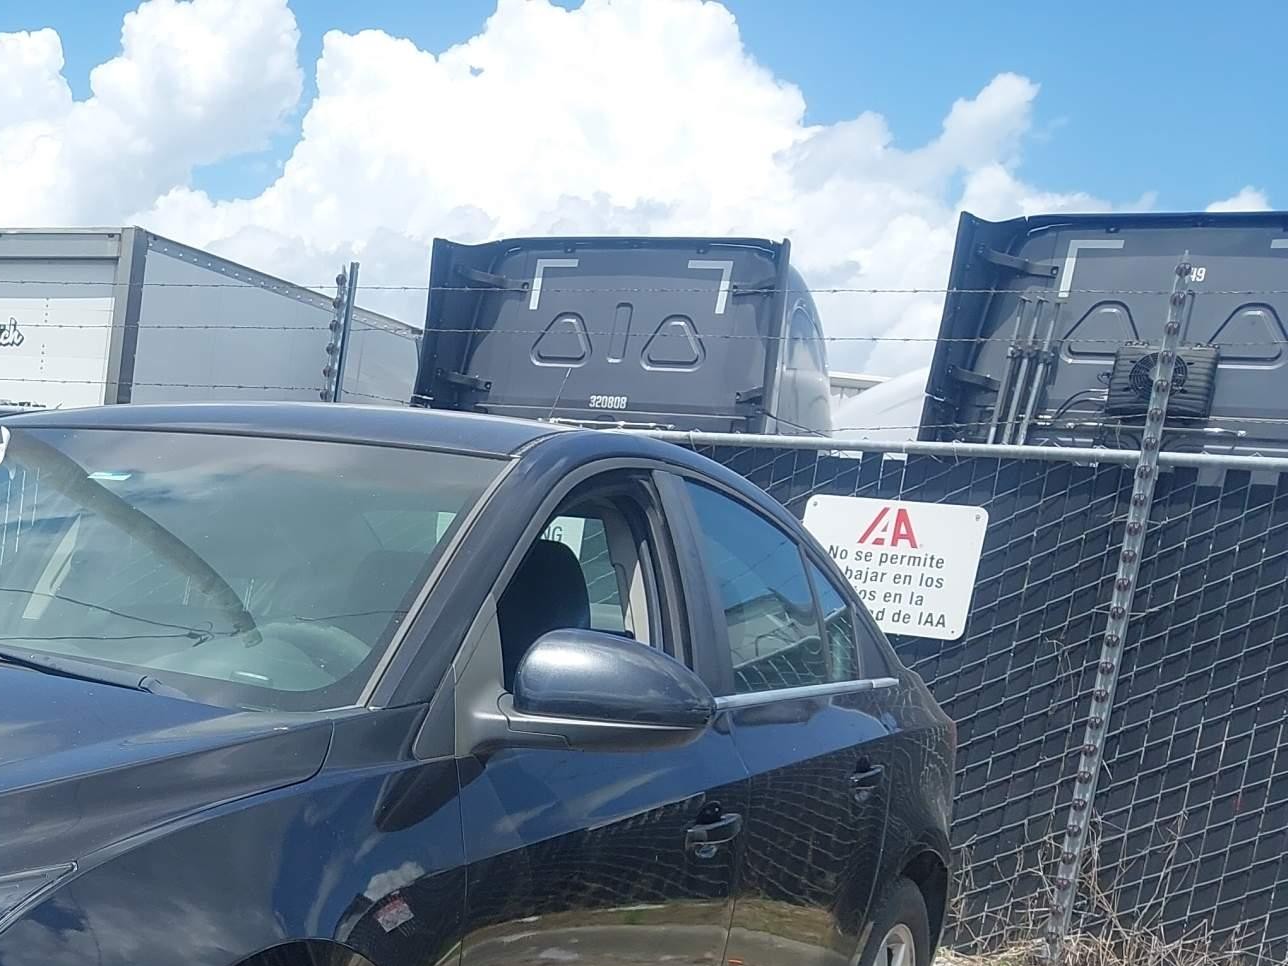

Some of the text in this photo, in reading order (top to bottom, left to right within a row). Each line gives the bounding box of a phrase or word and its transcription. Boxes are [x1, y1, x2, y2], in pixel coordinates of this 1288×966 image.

[588, 395, 627, 409] 320808
[828, 544, 945, 570] No se permite
[844, 565, 945, 589] bajar en los
[882, 591, 903, 604] en
[908, 591, 924, 606] la
[891, 609, 912, 624] de
[917, 611, 947, 628] IAA
